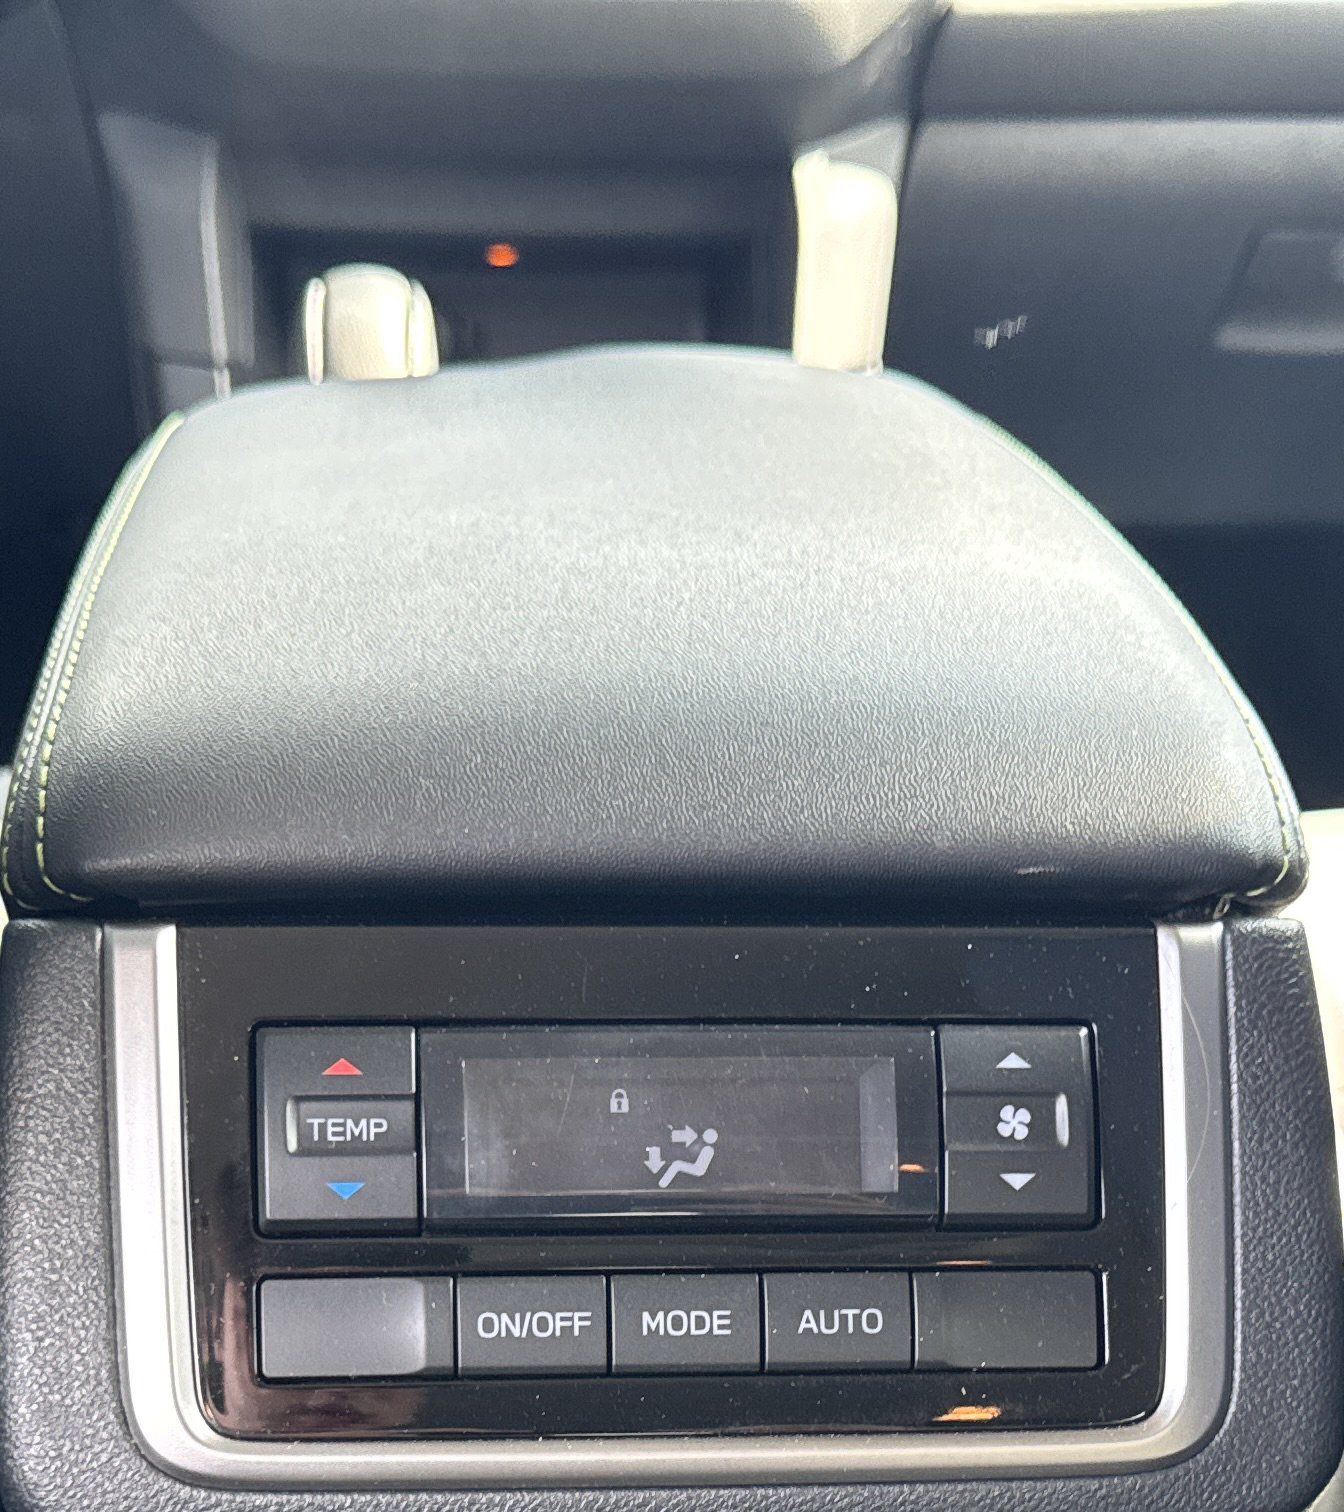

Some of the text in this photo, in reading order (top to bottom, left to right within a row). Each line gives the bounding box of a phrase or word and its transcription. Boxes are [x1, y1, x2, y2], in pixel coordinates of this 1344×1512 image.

[305, 1117, 389, 1143] TEMP
[476, 1309, 593, 1340] ON/OFF
[641, 1309, 733, 1338] MODE
[796, 1306, 885, 1336] AUTO
